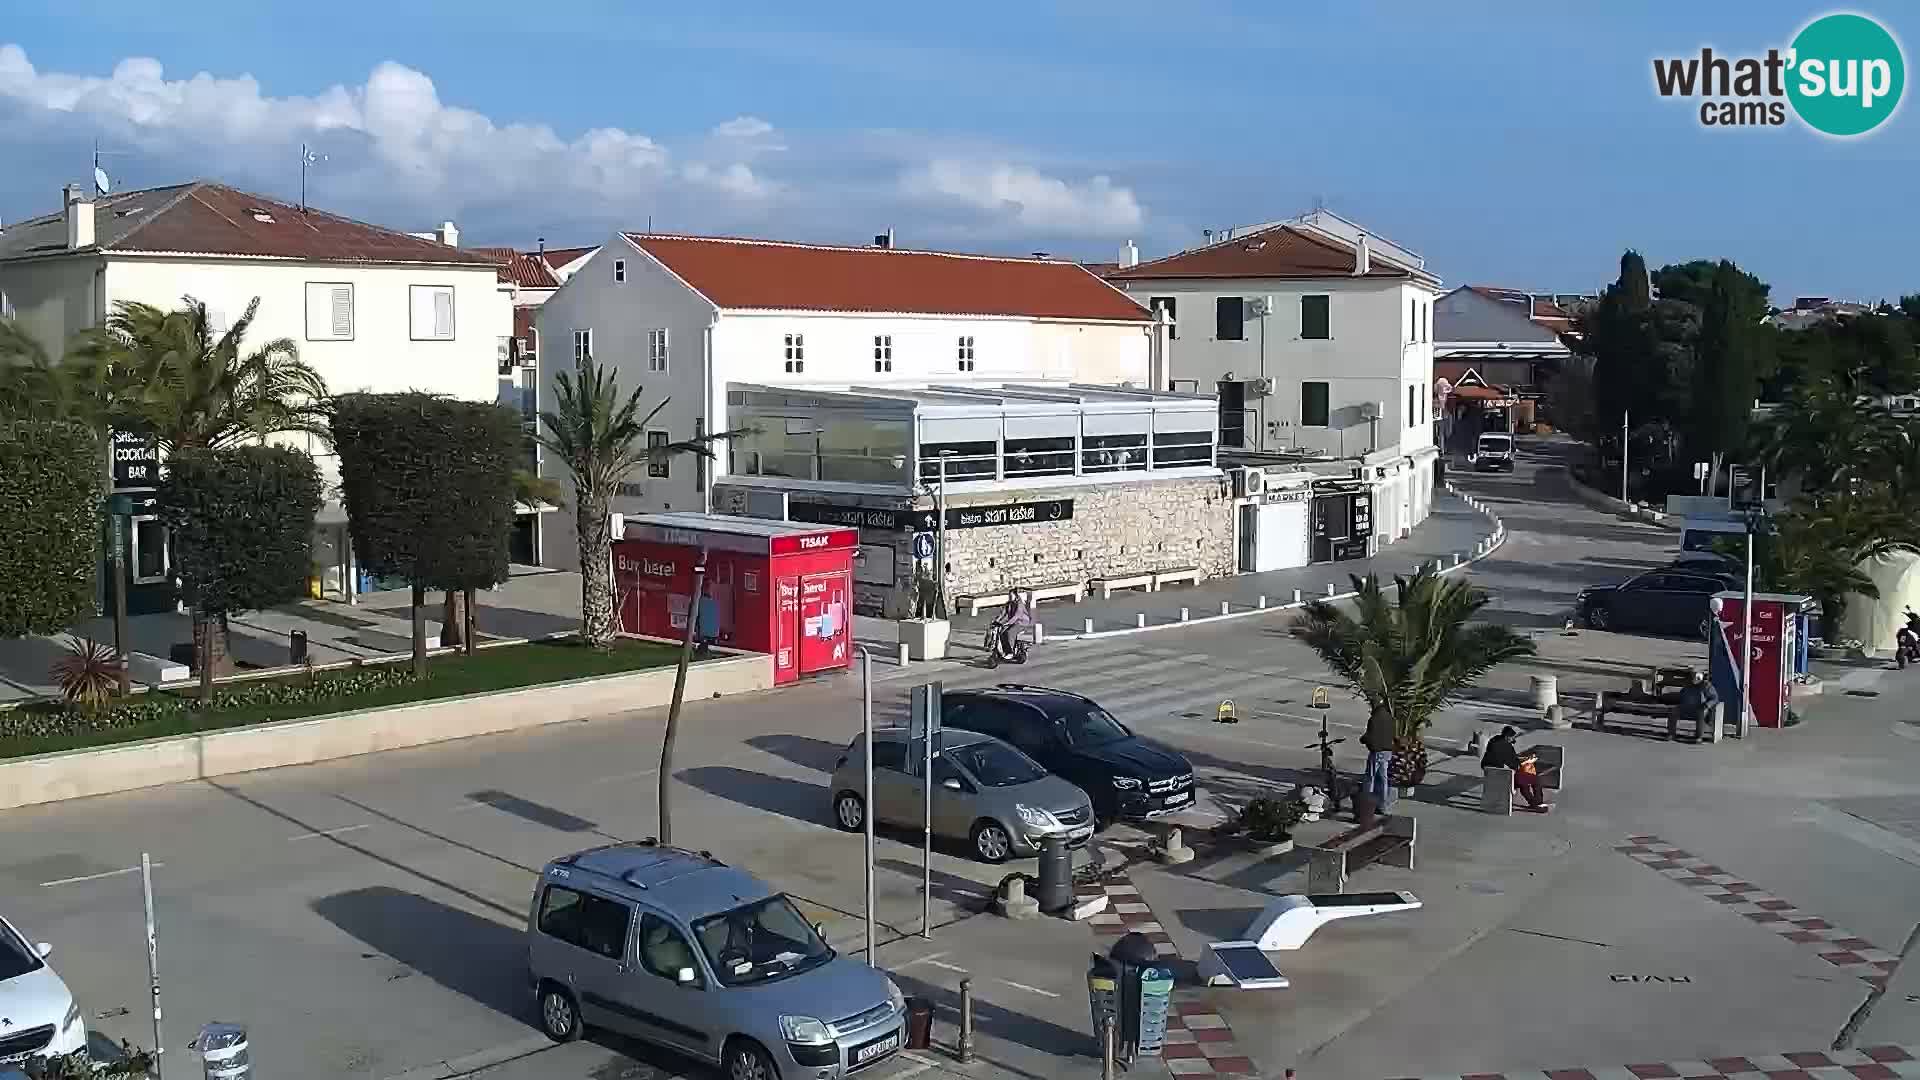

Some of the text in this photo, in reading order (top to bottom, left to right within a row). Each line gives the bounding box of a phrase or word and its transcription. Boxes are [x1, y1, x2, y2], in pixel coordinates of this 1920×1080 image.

[128, 465, 147, 479] BAR
[800, 535, 829, 549] TISAK
[618, 554, 675, 577] Buy here!
[781, 584, 799, 598] Buy
